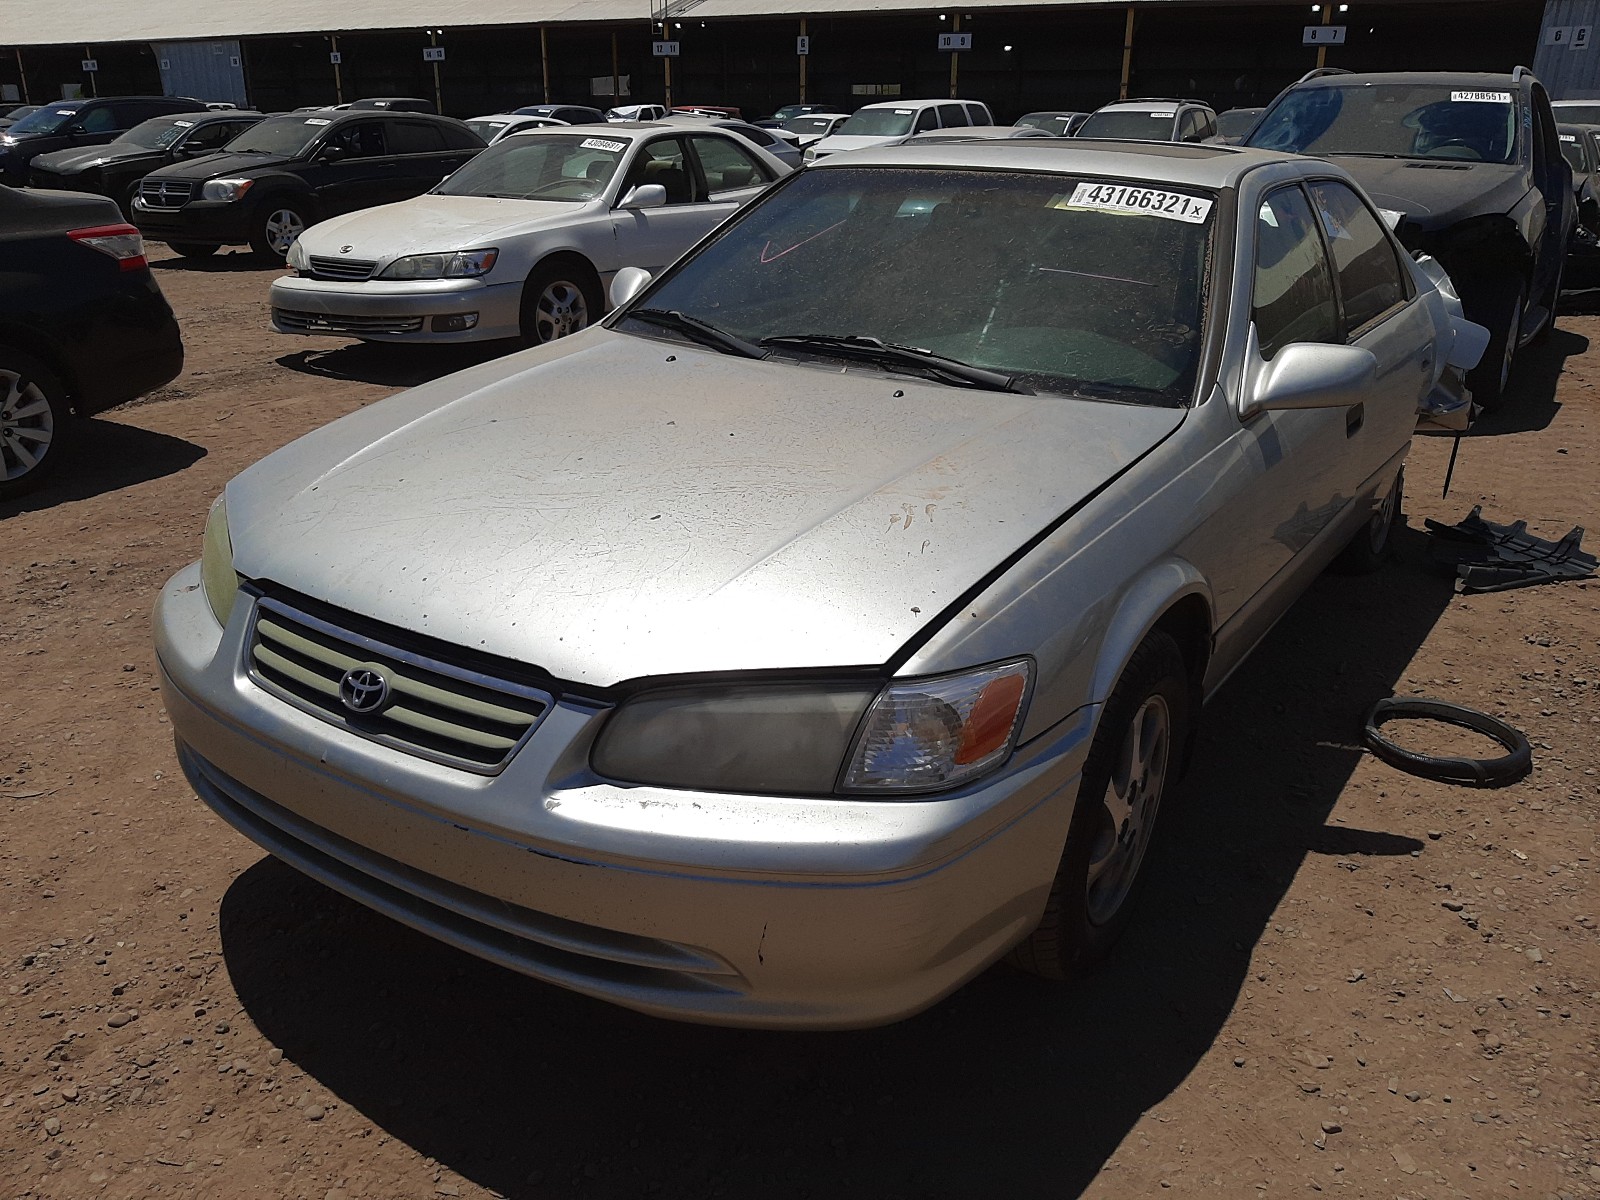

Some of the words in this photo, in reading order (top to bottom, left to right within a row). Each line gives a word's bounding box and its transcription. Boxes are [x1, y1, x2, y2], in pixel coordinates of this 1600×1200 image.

[1311, 30, 1317, 40] 8
[1332, 30, 1338, 40] 7
[1555, 30, 1562, 41] 6
[943, 37, 951, 46] 10
[960, 37, 966, 46] 9
[670, 44, 676, 53] 11
[1458, 92, 1502, 101] 42788551
[1087, 185, 1192, 215] 43166321
